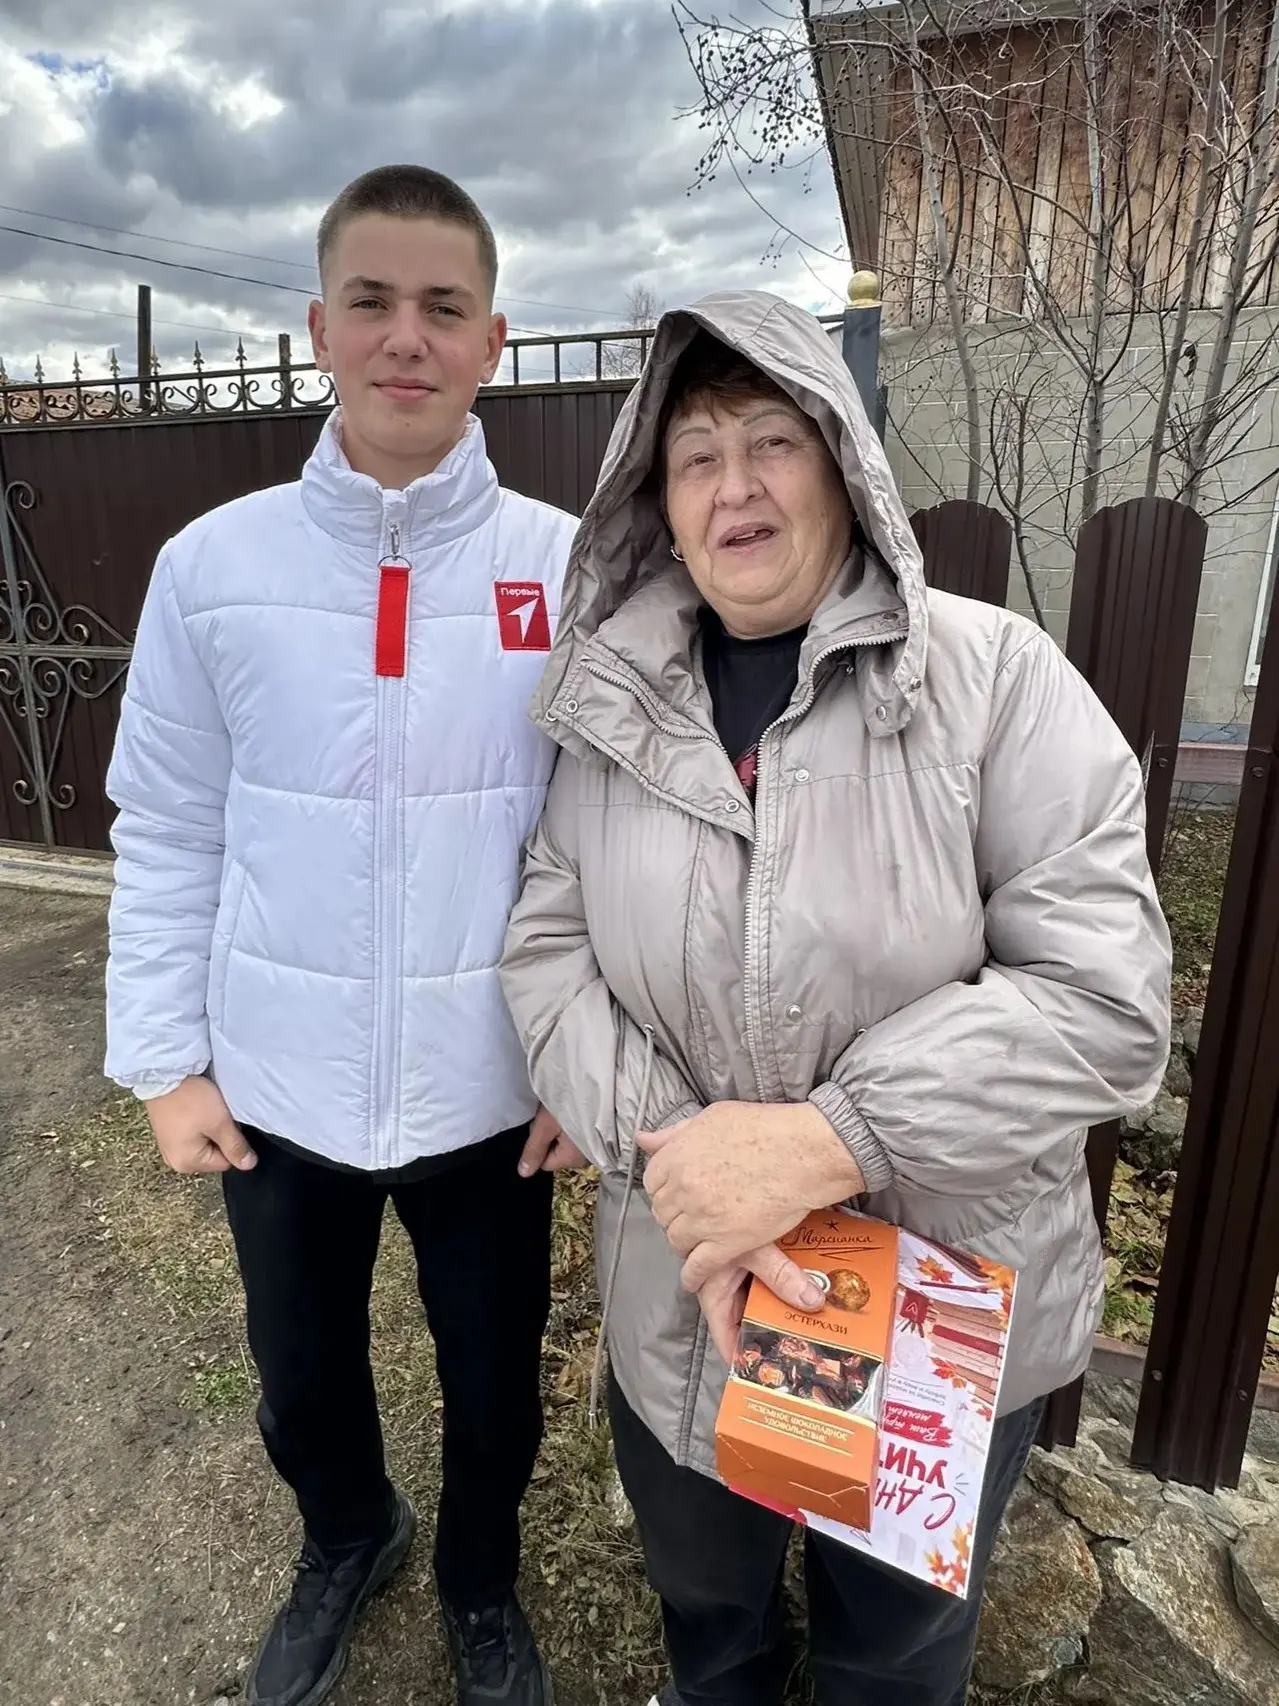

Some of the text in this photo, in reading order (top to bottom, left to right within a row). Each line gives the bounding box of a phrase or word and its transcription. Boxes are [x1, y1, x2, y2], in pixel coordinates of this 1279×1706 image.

[501, 588, 540, 597] Первые
[781, 1226, 873, 1250] Марсианка
[784, 1311, 848, 1335] ЭСТЕРХАЗИ
[747, 1402, 848, 1442] НЕЗЕМНОЕ ШОКОЛАДНОЕ
[764, 1416, 827, 1442] УДОВОЛЬСТВИЕ
[879, 1442, 948, 1490] УЧИ
[924, 1493, 956, 1530] С
